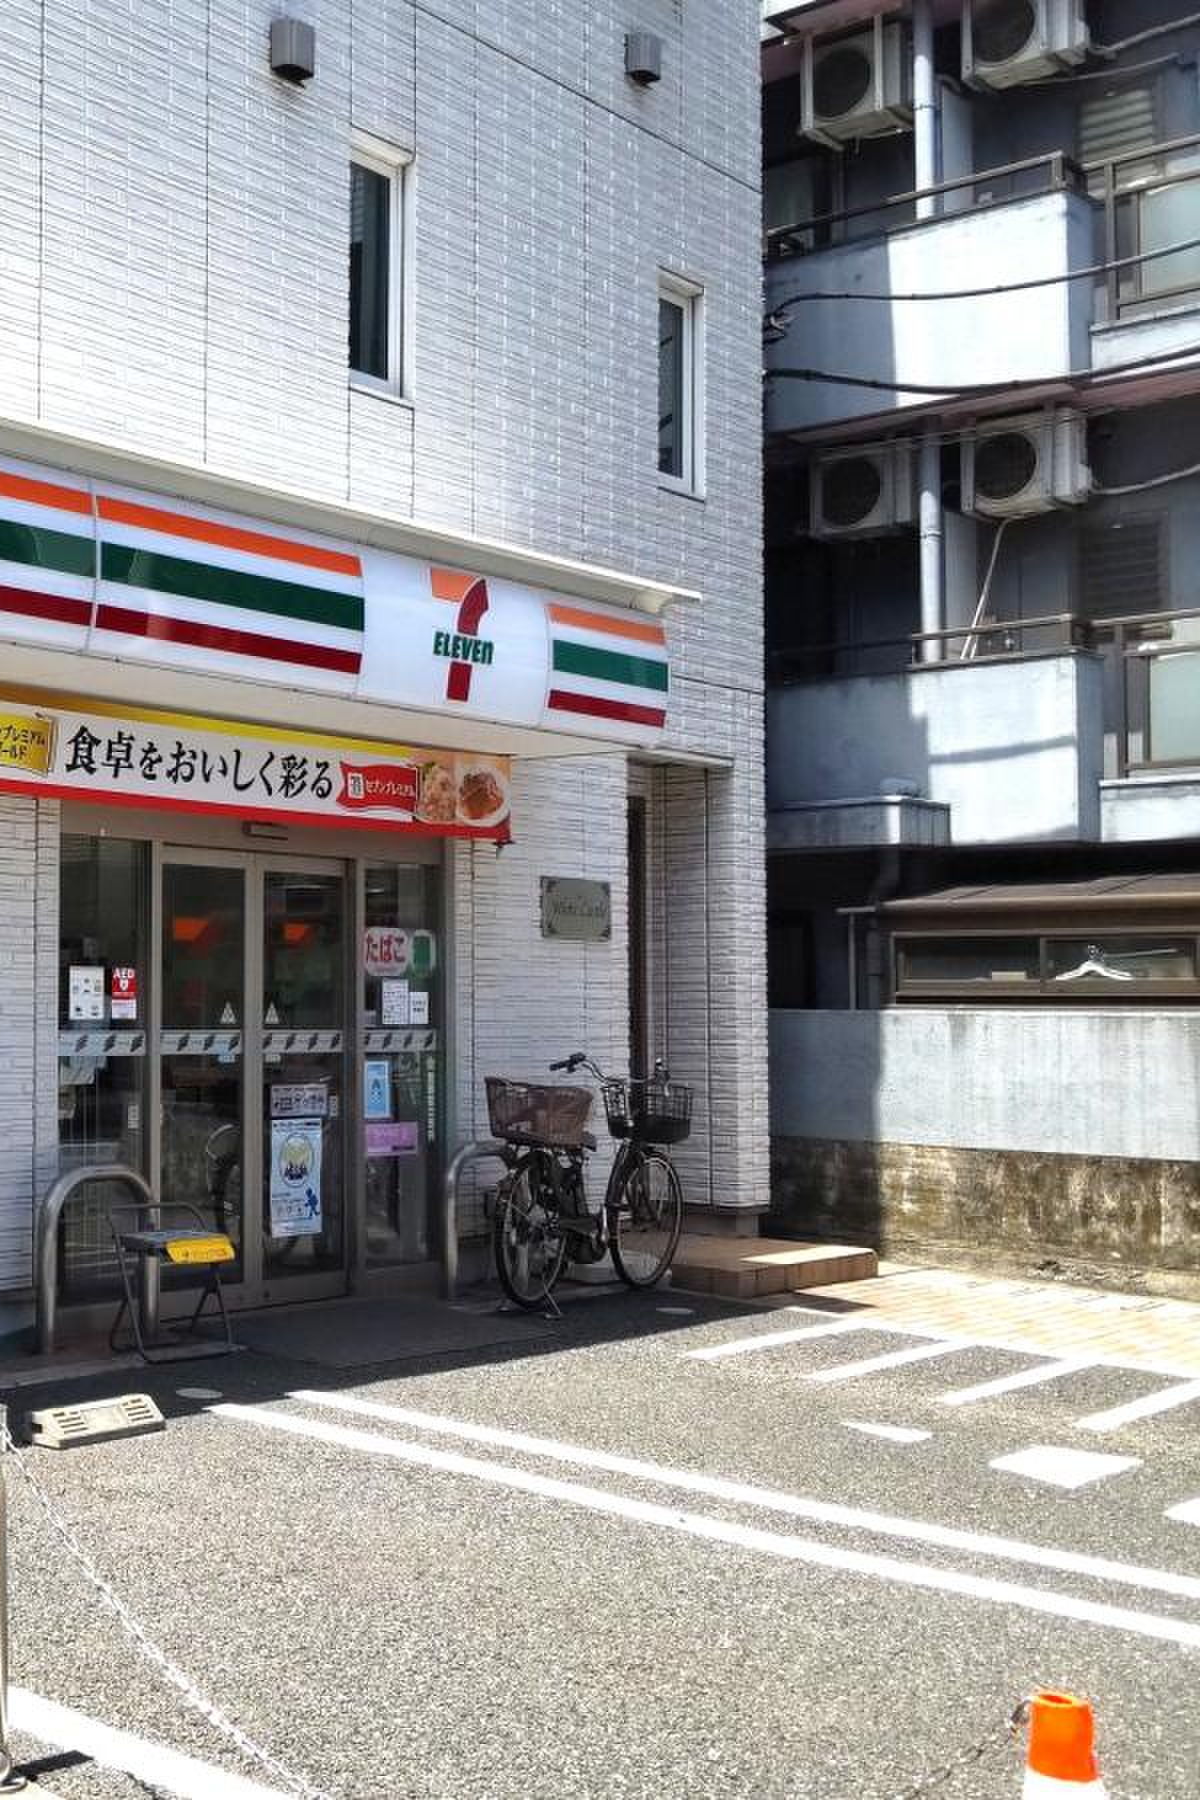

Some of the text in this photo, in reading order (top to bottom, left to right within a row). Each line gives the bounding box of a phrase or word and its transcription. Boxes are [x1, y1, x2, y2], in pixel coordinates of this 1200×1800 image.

[65, 724, 333, 799] 食卓をおいしく彩る
[366, 934, 406, 963] たばこ
